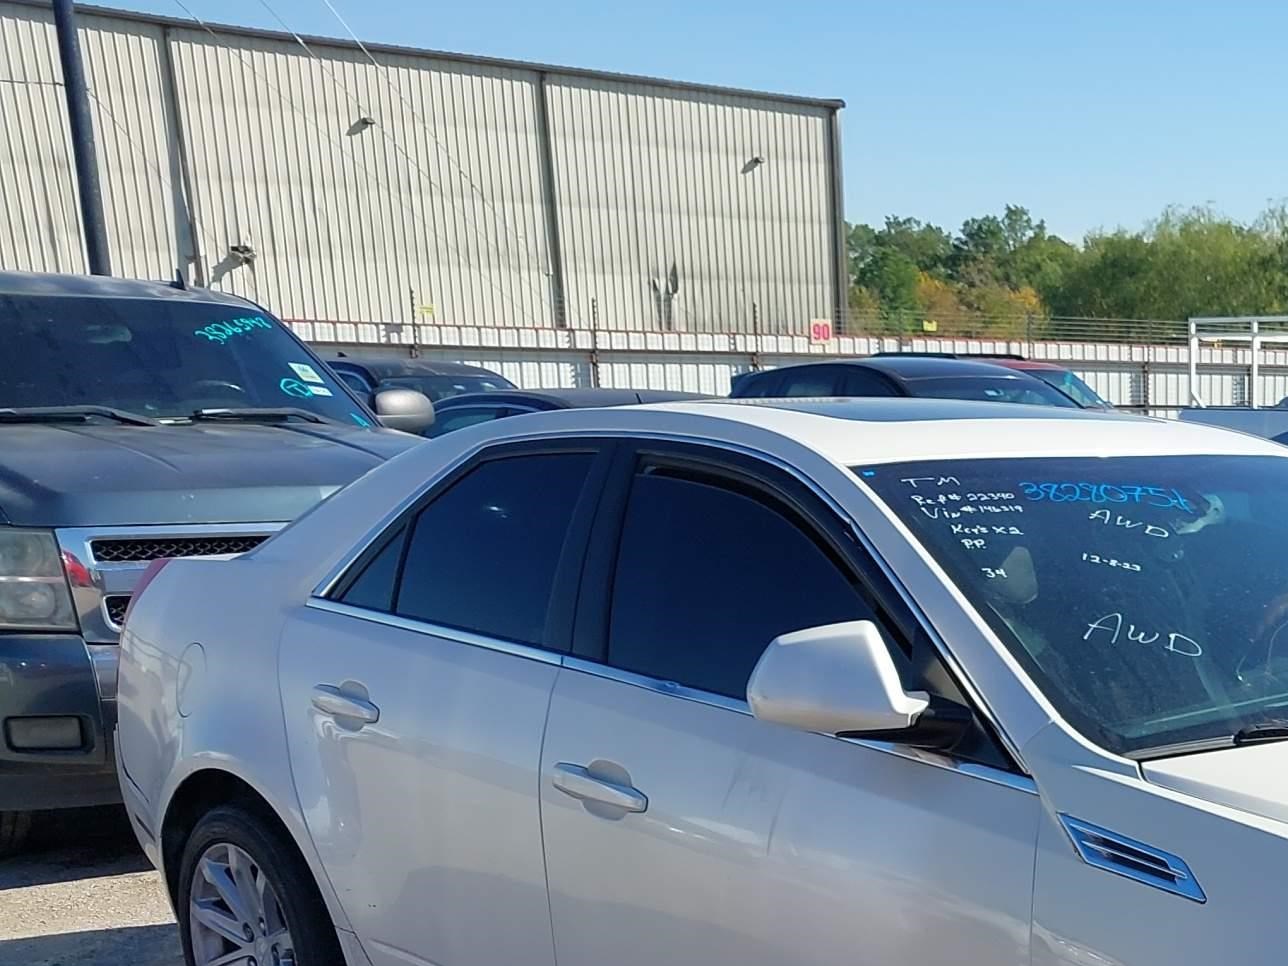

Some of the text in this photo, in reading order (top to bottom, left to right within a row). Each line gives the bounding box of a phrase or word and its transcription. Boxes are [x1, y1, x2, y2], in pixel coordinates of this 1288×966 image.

[813, 323, 829, 340] 90
[1088, 509, 1169, 538] AWD
[1083, 612, 1202, 657] AWD
